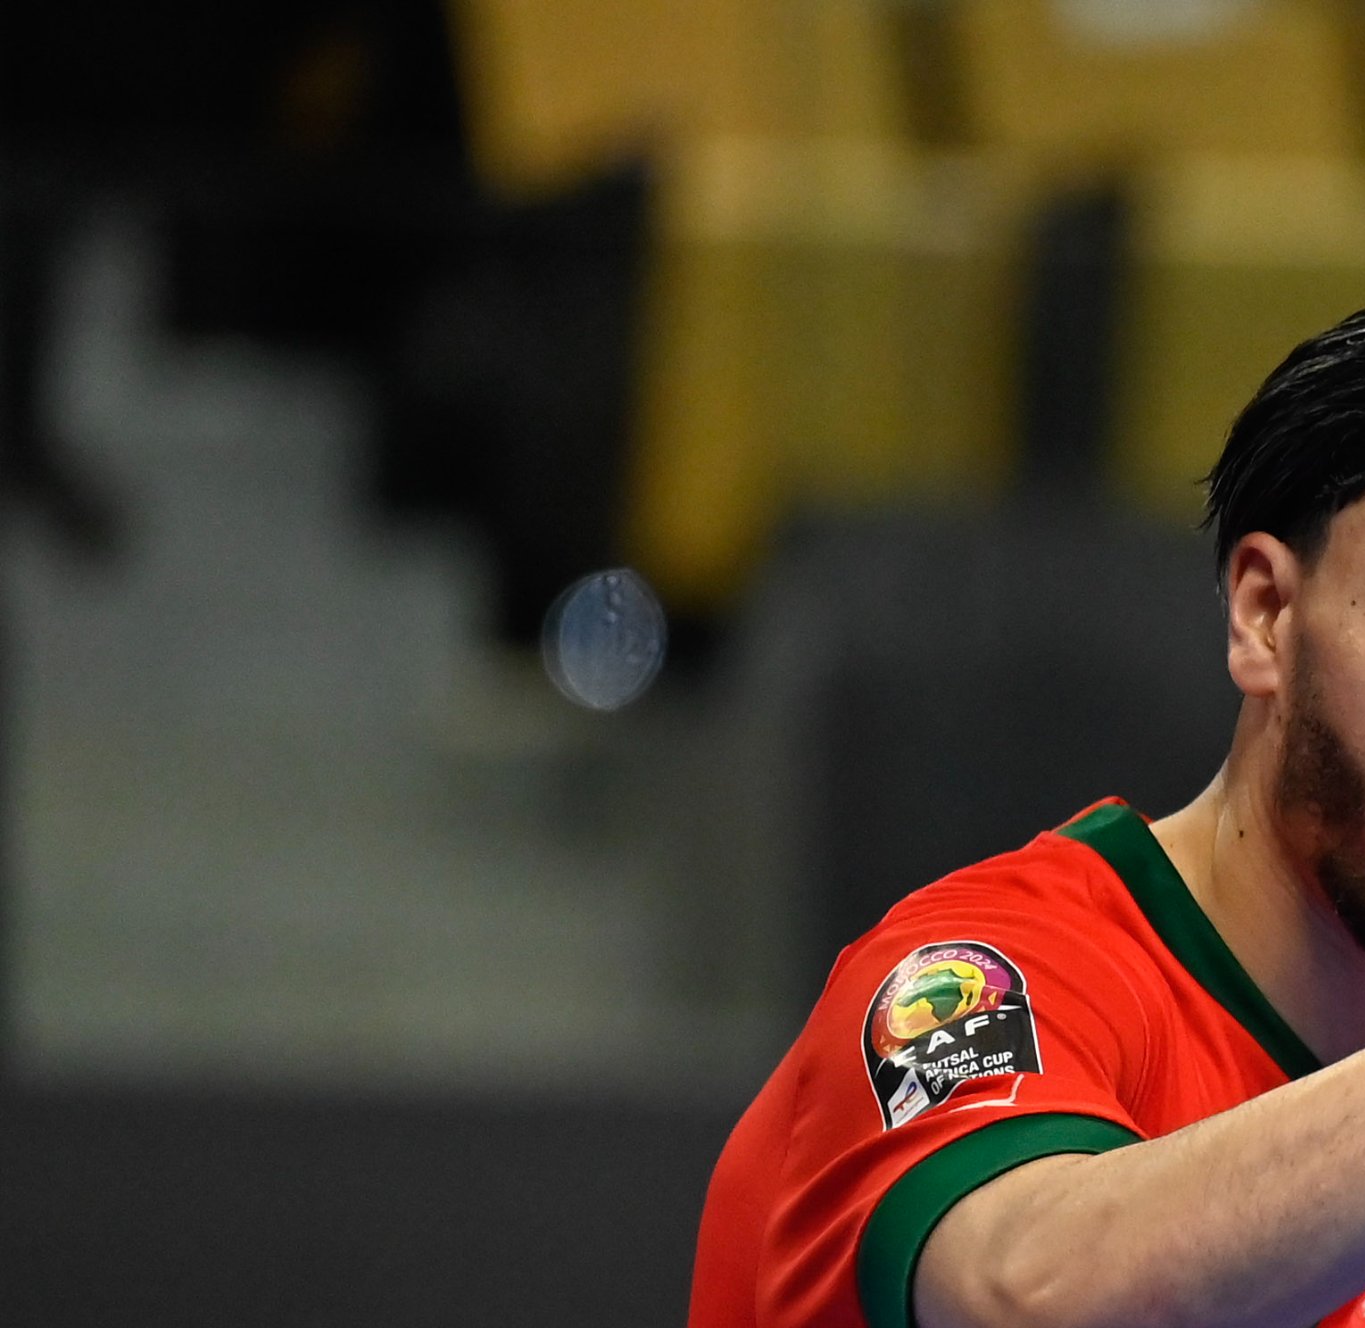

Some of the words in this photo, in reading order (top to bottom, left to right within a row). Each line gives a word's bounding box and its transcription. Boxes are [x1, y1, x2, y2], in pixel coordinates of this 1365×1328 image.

[960, 951, 998, 970] 2024
[922, 1047, 979, 1069] FUTSAL
[982, 1051, 1013, 1068] CUP
[930, 1074, 945, 1095] OF
